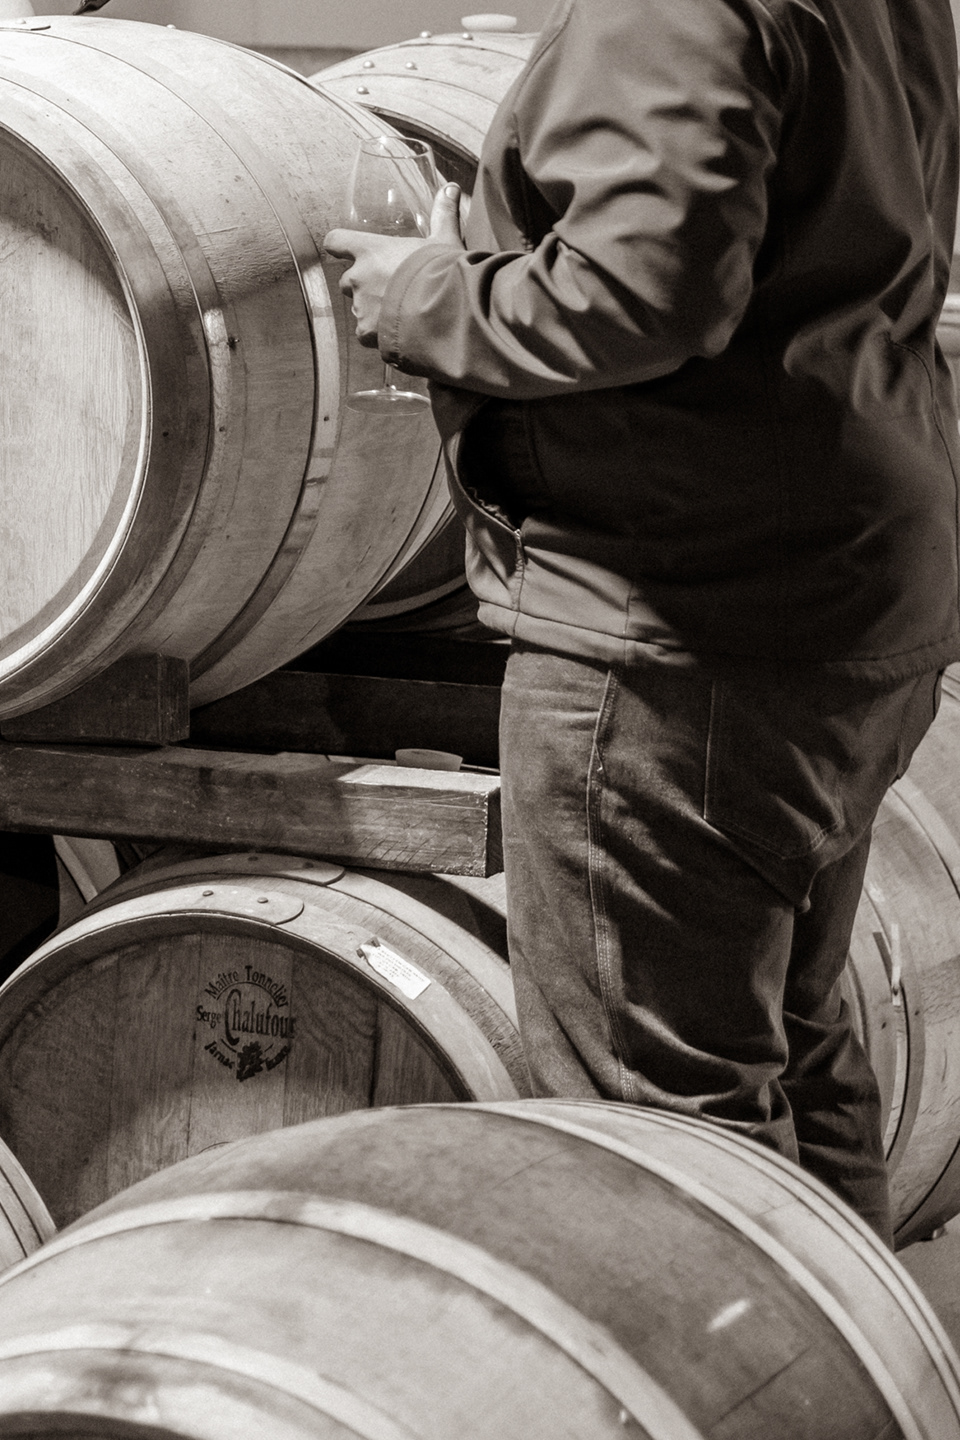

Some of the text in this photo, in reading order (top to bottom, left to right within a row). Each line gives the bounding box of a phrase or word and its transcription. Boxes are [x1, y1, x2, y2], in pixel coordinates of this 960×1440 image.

[204, 964, 289, 1008] Maître Tonnelier
[196, 1004, 221, 1029] Serge
